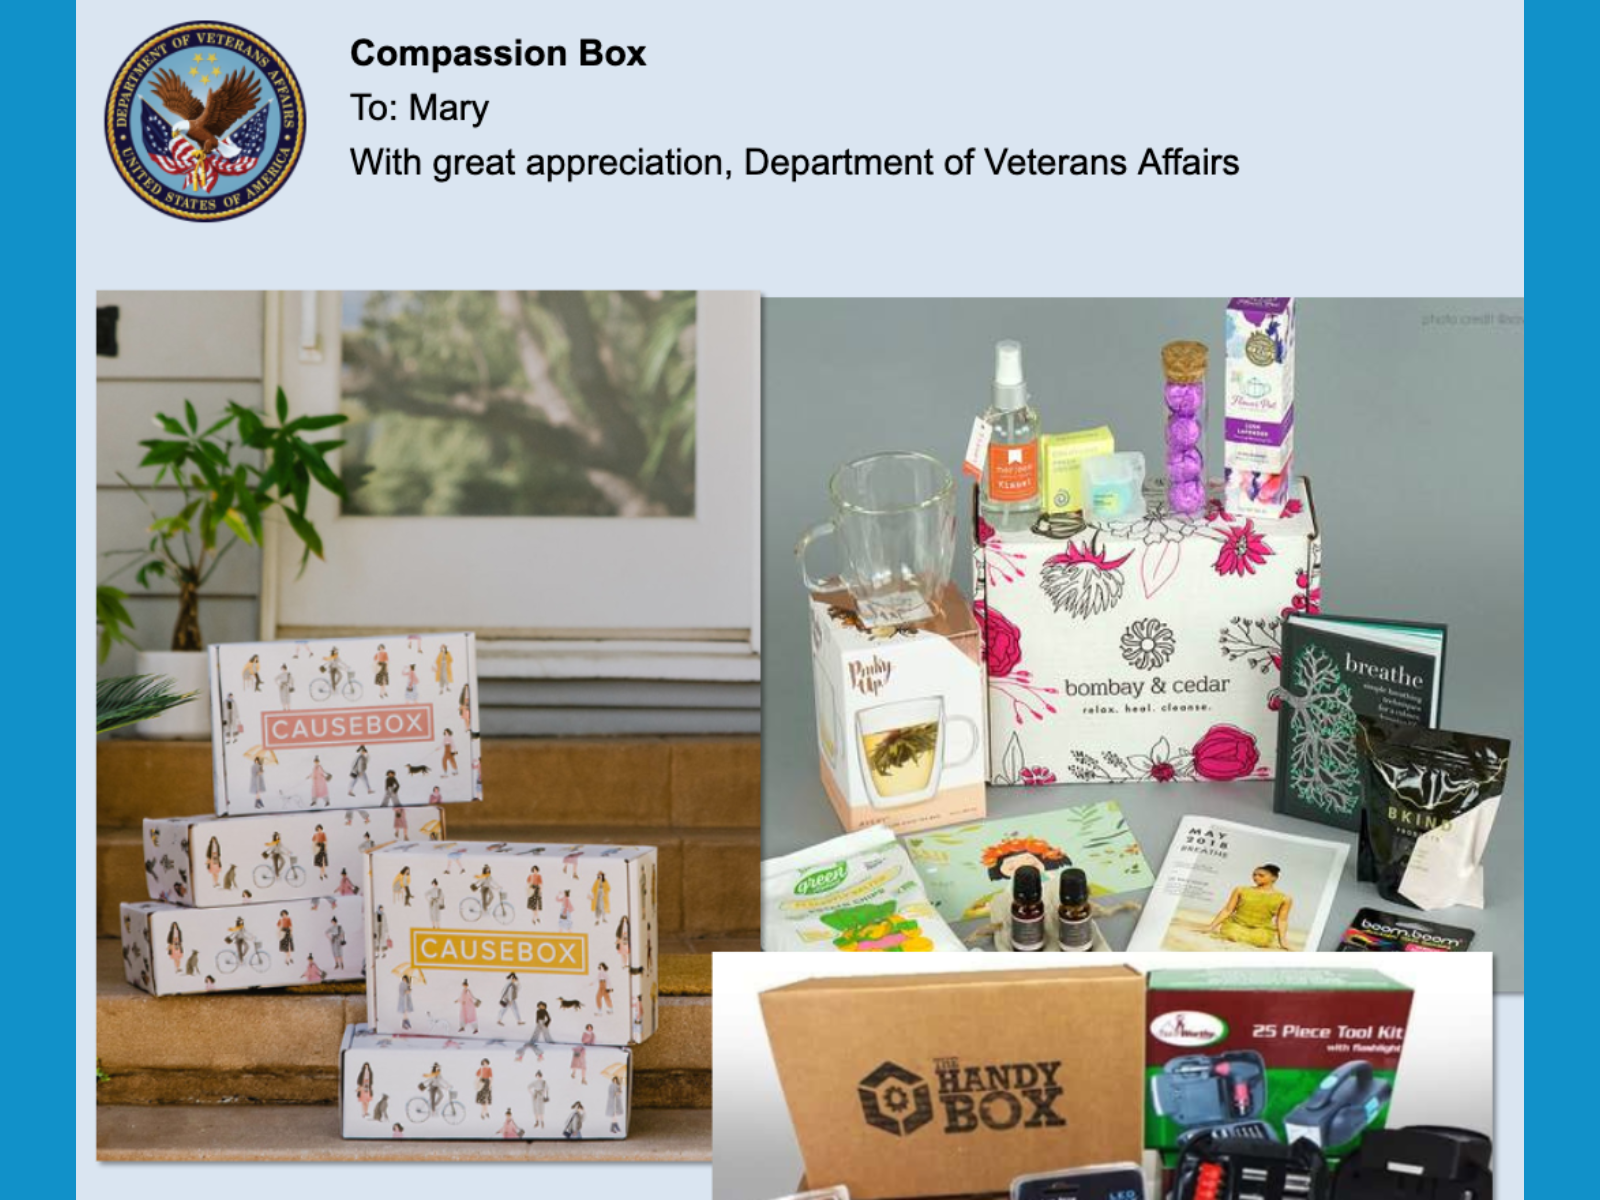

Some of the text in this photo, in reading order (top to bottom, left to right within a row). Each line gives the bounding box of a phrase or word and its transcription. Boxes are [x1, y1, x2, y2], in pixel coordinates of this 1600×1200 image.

[116, 32, 295, 129] DEPARTMENT OF VETERANS AFFAIRS
[122, 147, 291, 211] UNITED STATES OF AMERICA
[1345, 652, 1424, 689] breathe
[1065, 675, 1230, 699] bombay & cedar
[1083, 703, 1211, 714] relax. heal. cleanse.
[271, 712, 423, 740] CAUSEBOX
[1388, 806, 1453, 832] BKIND
[1186, 836, 1229, 849] 2018
[1188, 828, 1228, 840] MAY
[1180, 845, 1229, 859] BREATHE
[798, 867, 846, 895] green
[420, 938, 576, 964] CAUSEBOX
[1252, 1024, 1404, 1040] 25 Piece Tool Kit
[1326, 1043, 1350, 1053] with
[933, 1057, 959, 1070] THE
[935, 1061, 1062, 1093] HANDY
[939, 1087, 1067, 1134] BOX
